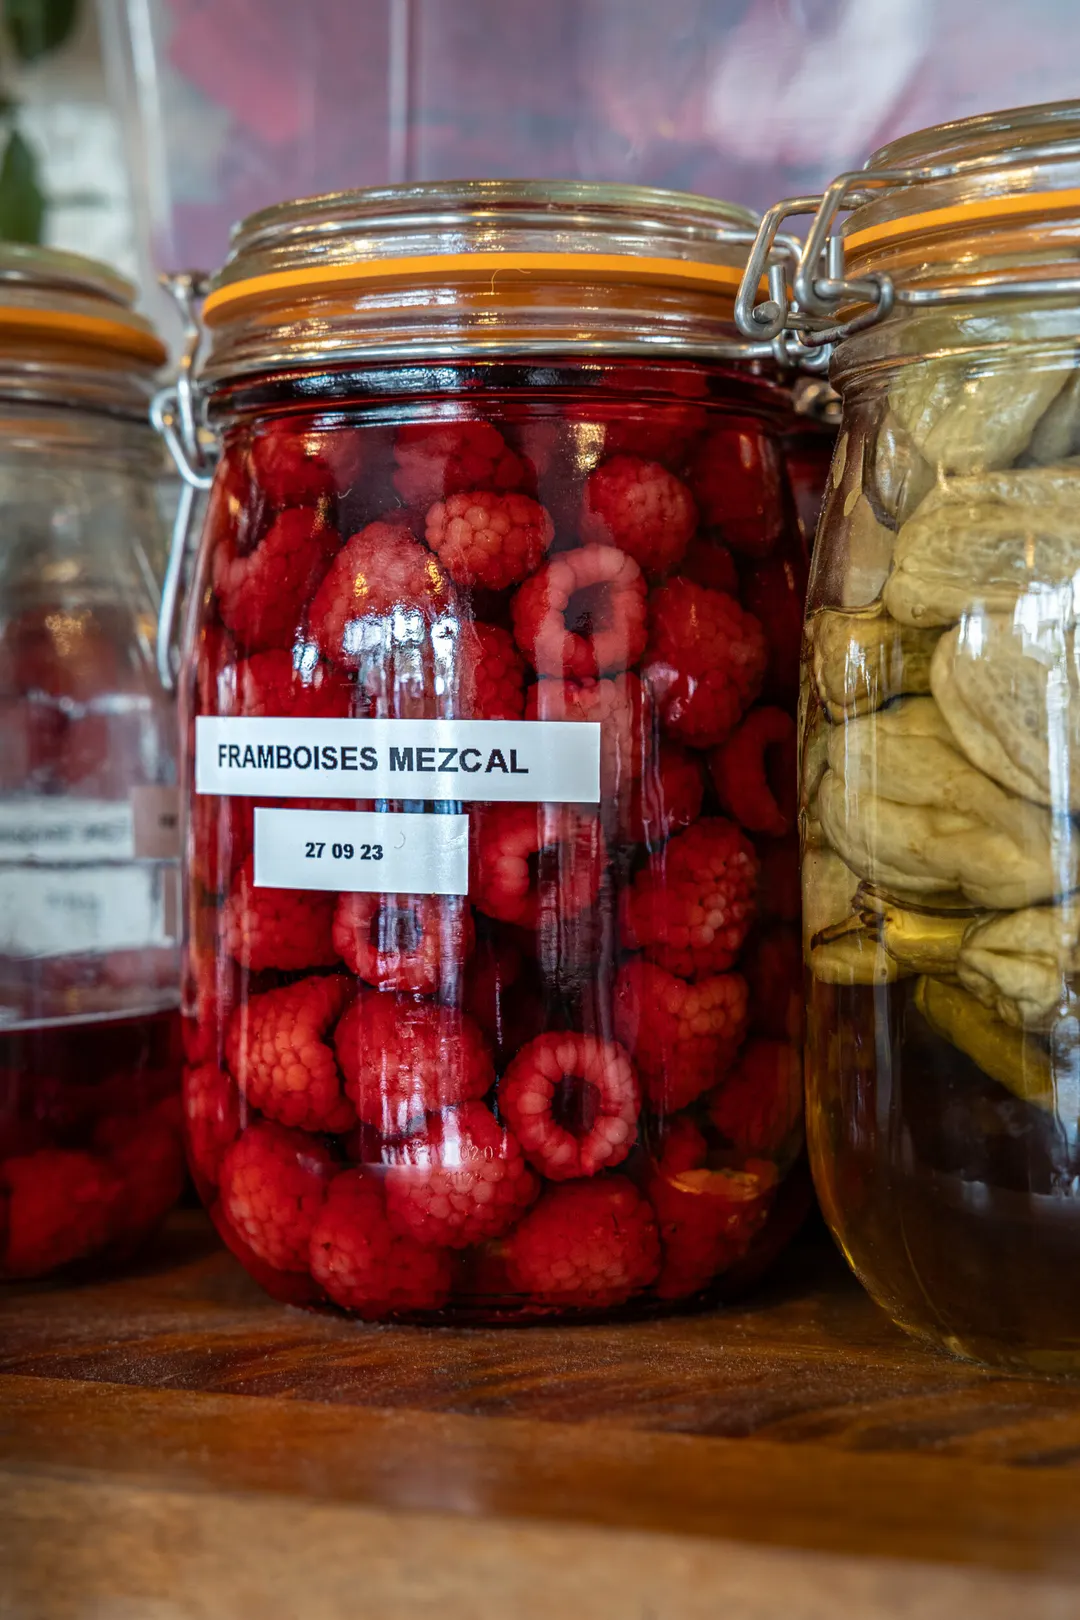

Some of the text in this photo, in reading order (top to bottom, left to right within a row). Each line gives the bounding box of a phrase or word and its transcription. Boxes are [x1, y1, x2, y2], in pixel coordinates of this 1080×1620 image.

[218, 744, 529, 774] FRAMBOISES MEZCAL
[305, 842, 383, 861] 27 09 23
